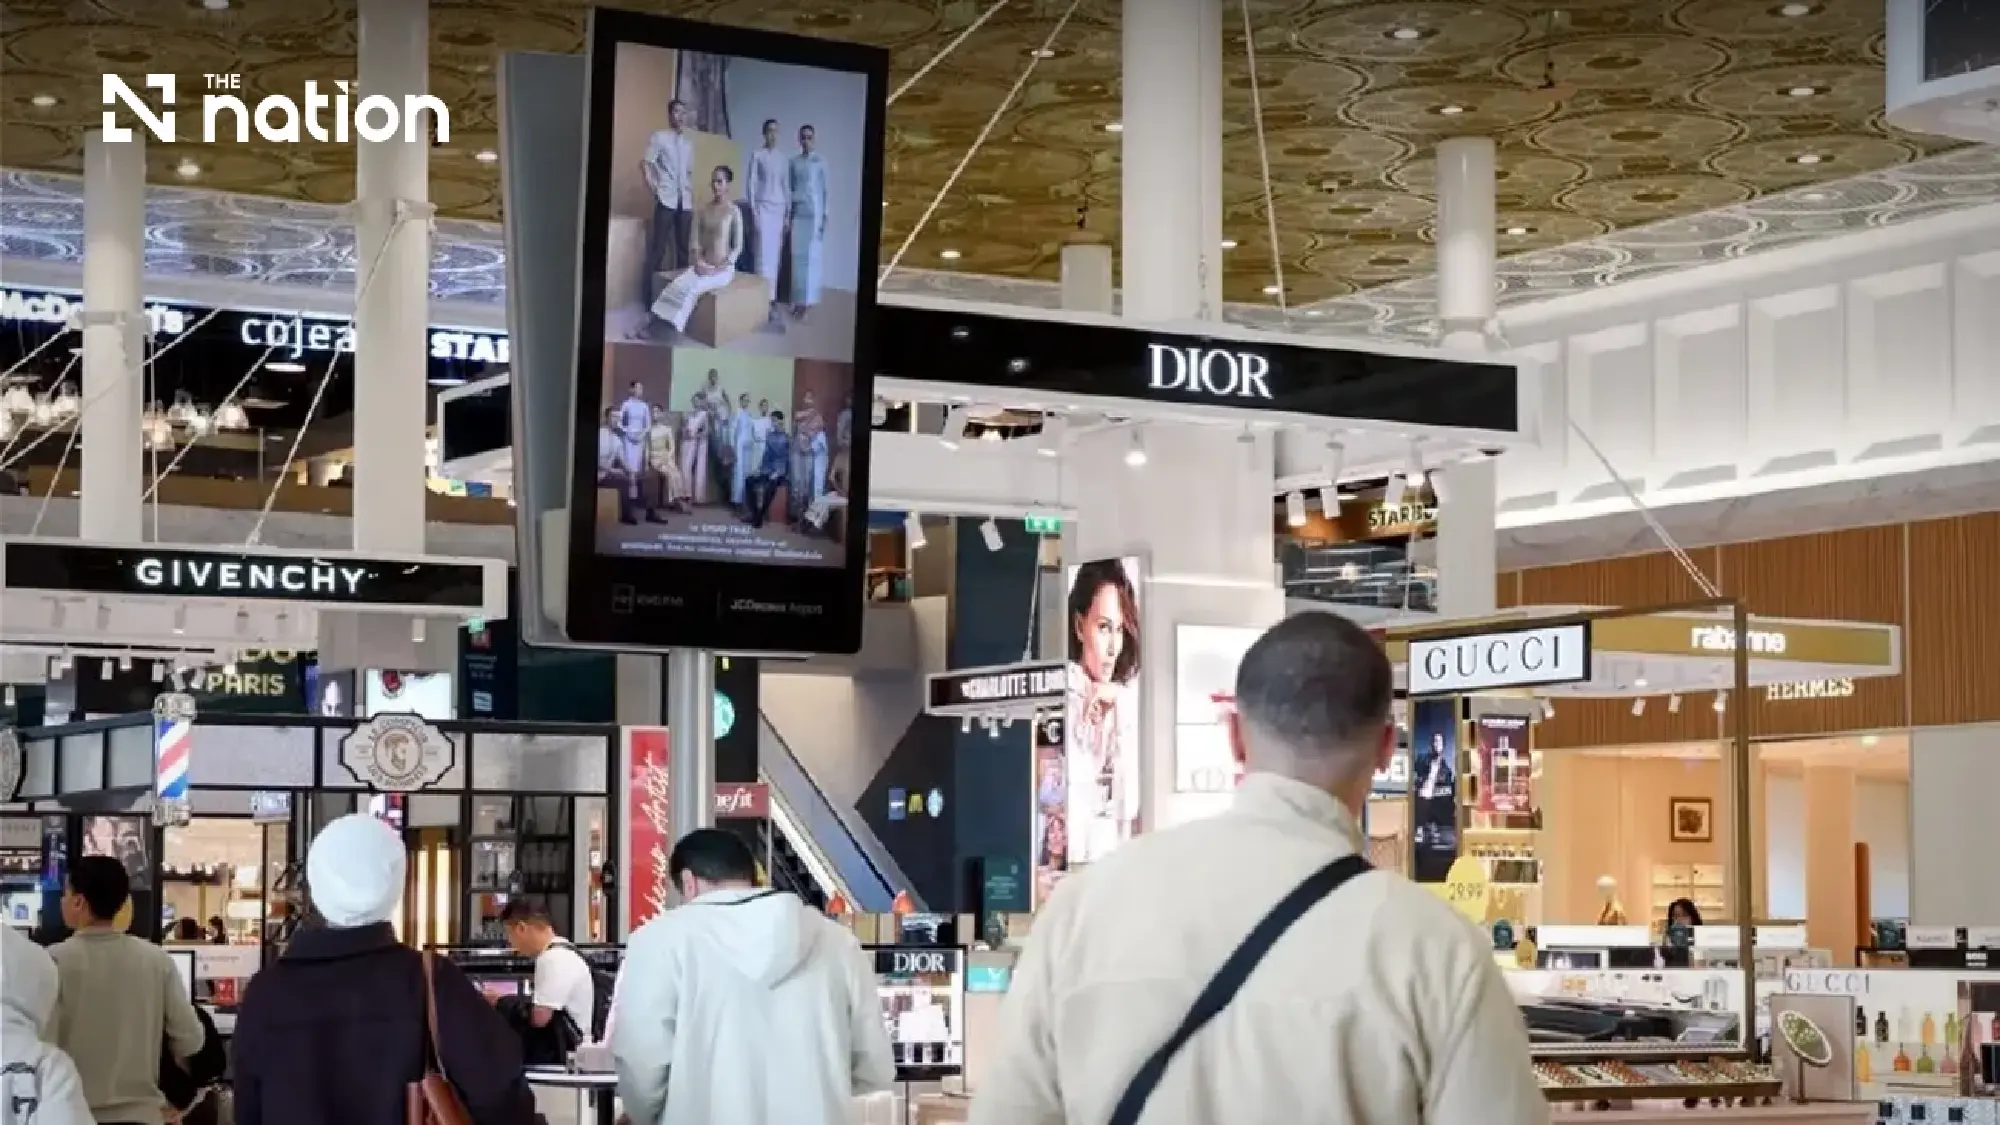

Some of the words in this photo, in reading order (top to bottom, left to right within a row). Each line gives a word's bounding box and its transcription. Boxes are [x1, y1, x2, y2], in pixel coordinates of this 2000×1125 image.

[241, 318, 357, 359] cojea
[1147, 342, 1275, 400] DIOR
[1368, 502, 1438, 530] STARBU
[135, 557, 366, 595] GIVENCHY
[1425, 635, 1561, 681] GUCCI
[207, 672, 286, 697] PARIS
[714, 787, 753, 812] nefit
[893, 952, 946, 973] DIOR
[1785, 972, 1871, 994] GUCCI
